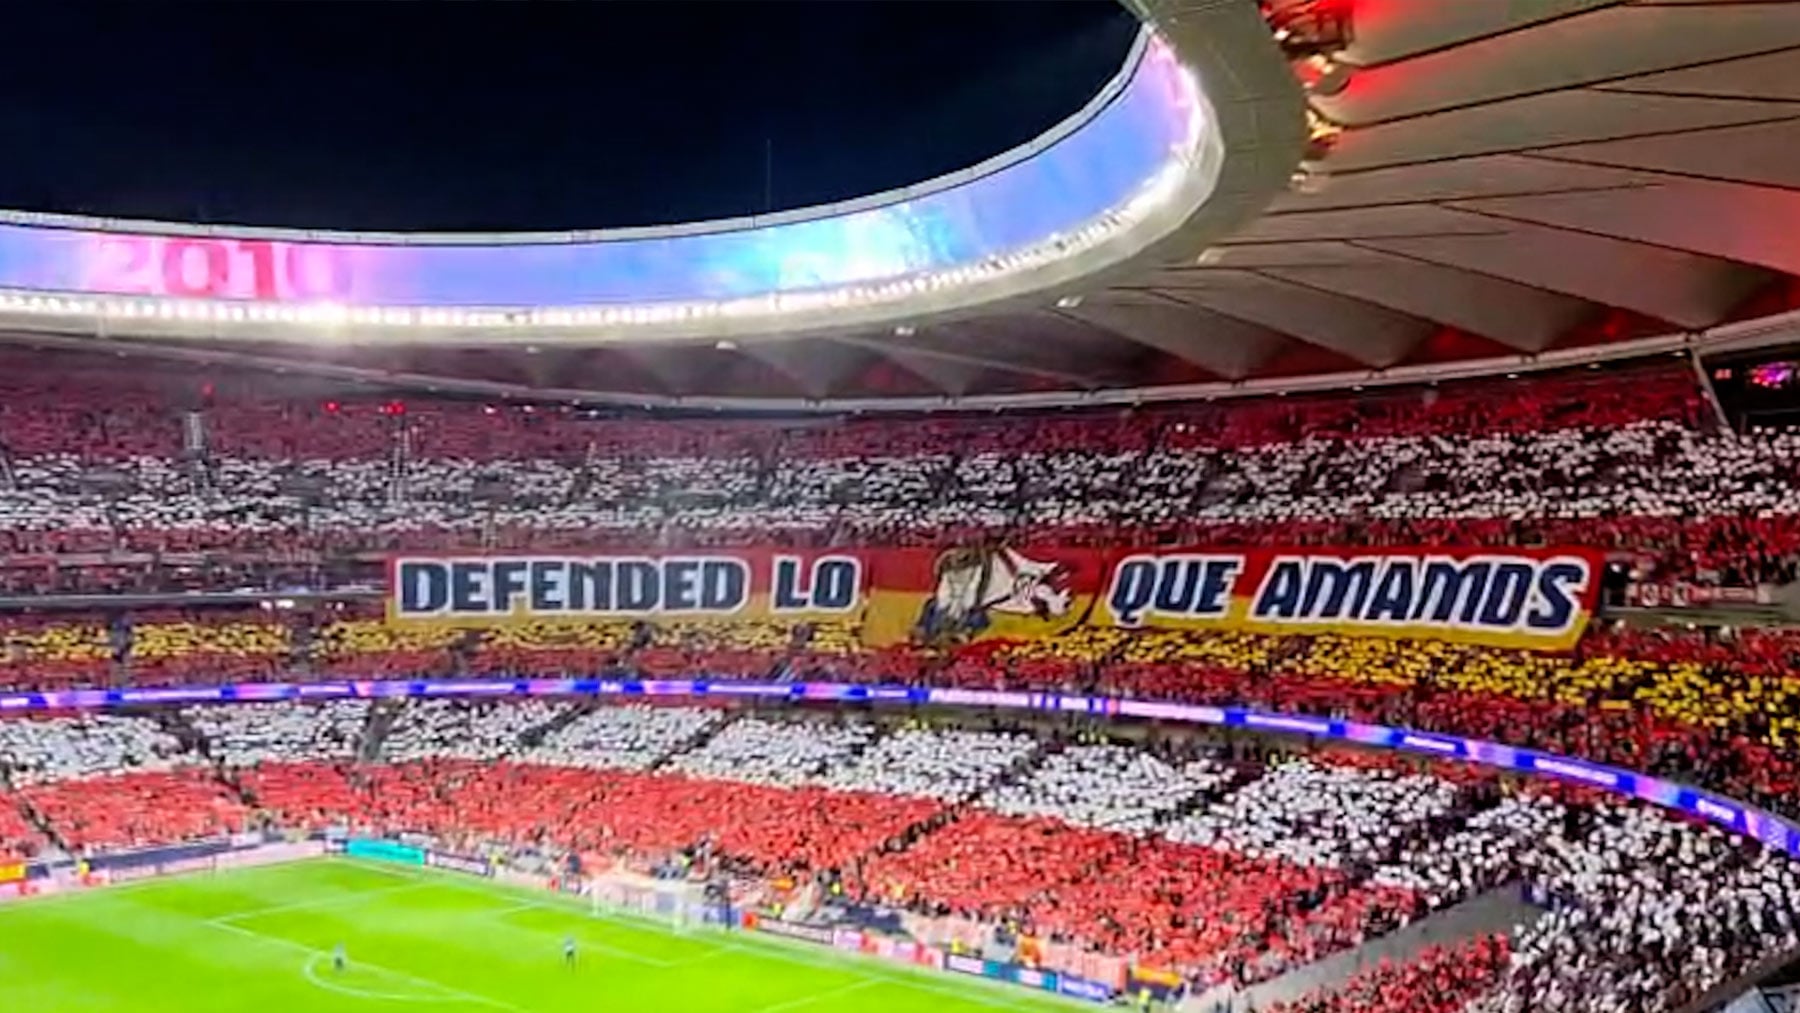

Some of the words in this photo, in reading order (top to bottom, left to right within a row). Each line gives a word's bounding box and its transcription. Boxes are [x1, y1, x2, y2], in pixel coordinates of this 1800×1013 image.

[398, 559, 747, 614] DEFENDED
[774, 558, 861, 610] LO
[1110, 558, 1242, 622] QUE
[1254, 560, 1586, 629] AMAMOS
